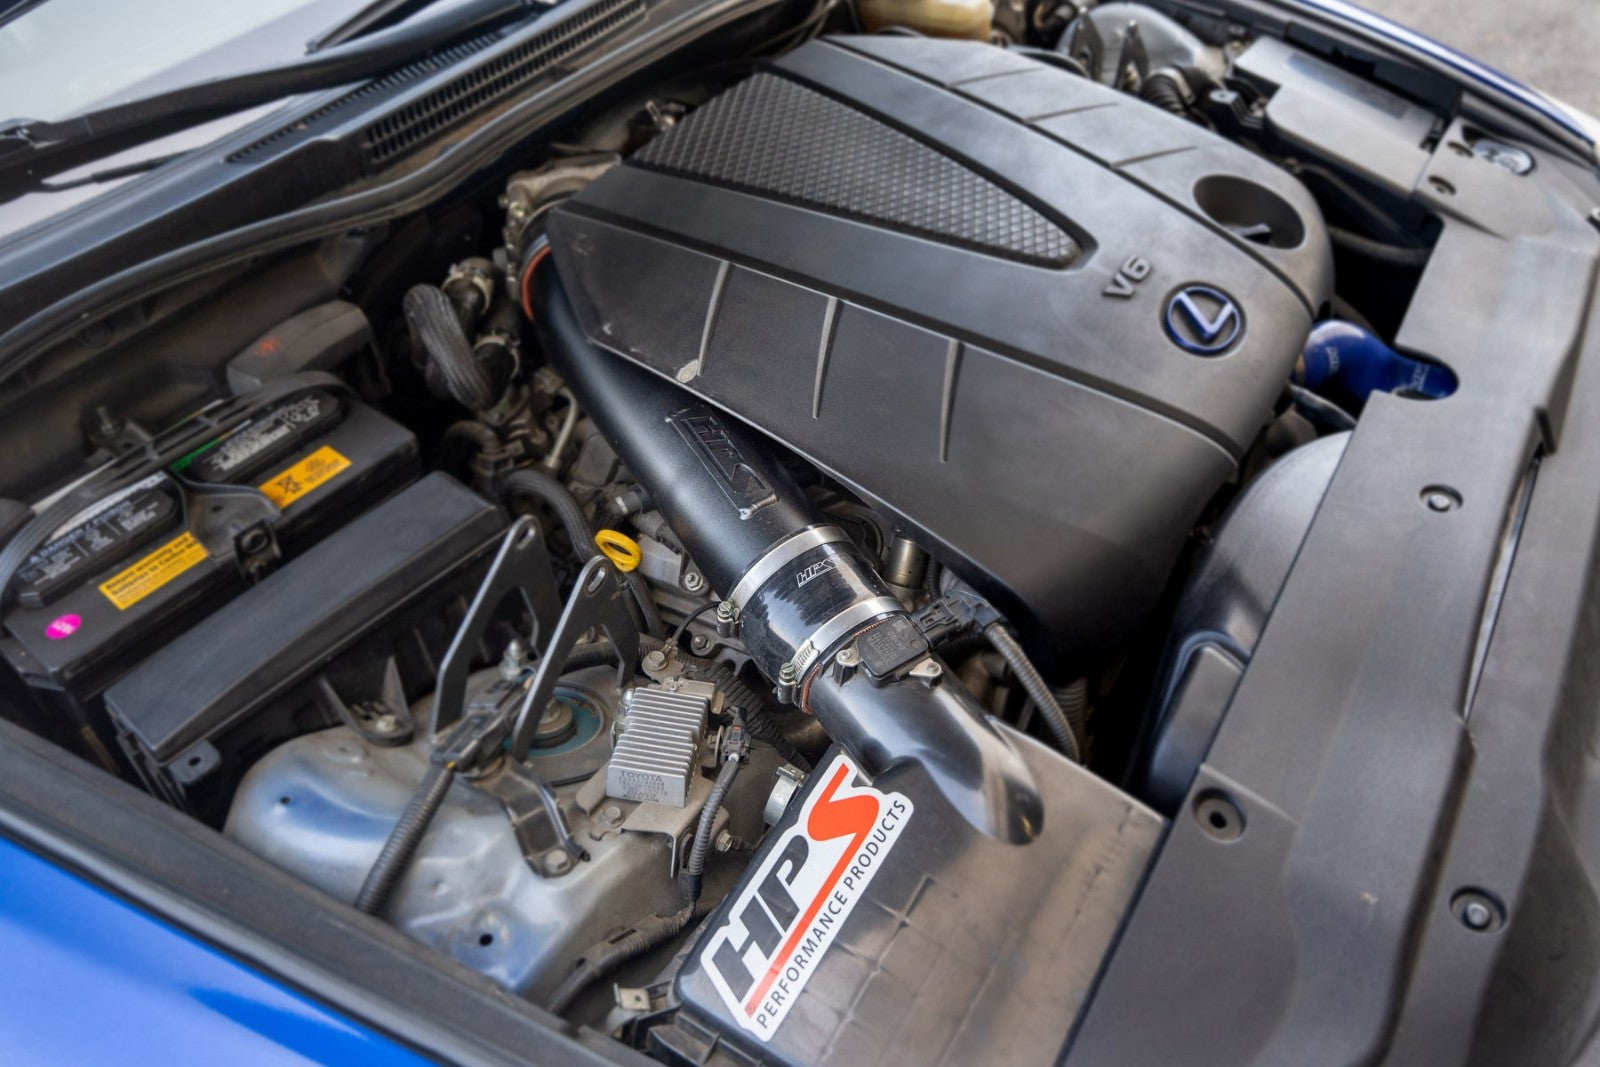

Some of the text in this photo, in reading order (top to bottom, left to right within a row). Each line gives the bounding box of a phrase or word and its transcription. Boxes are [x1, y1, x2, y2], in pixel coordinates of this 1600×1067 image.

[1103, 255, 1152, 299] V6
[796, 554, 837, 588] HPS
[621, 770, 664, 783] TOYOTA
[711, 762, 880, 1019] HPS
[756, 799, 907, 1029] PERFORMANCE PRODUCTS
